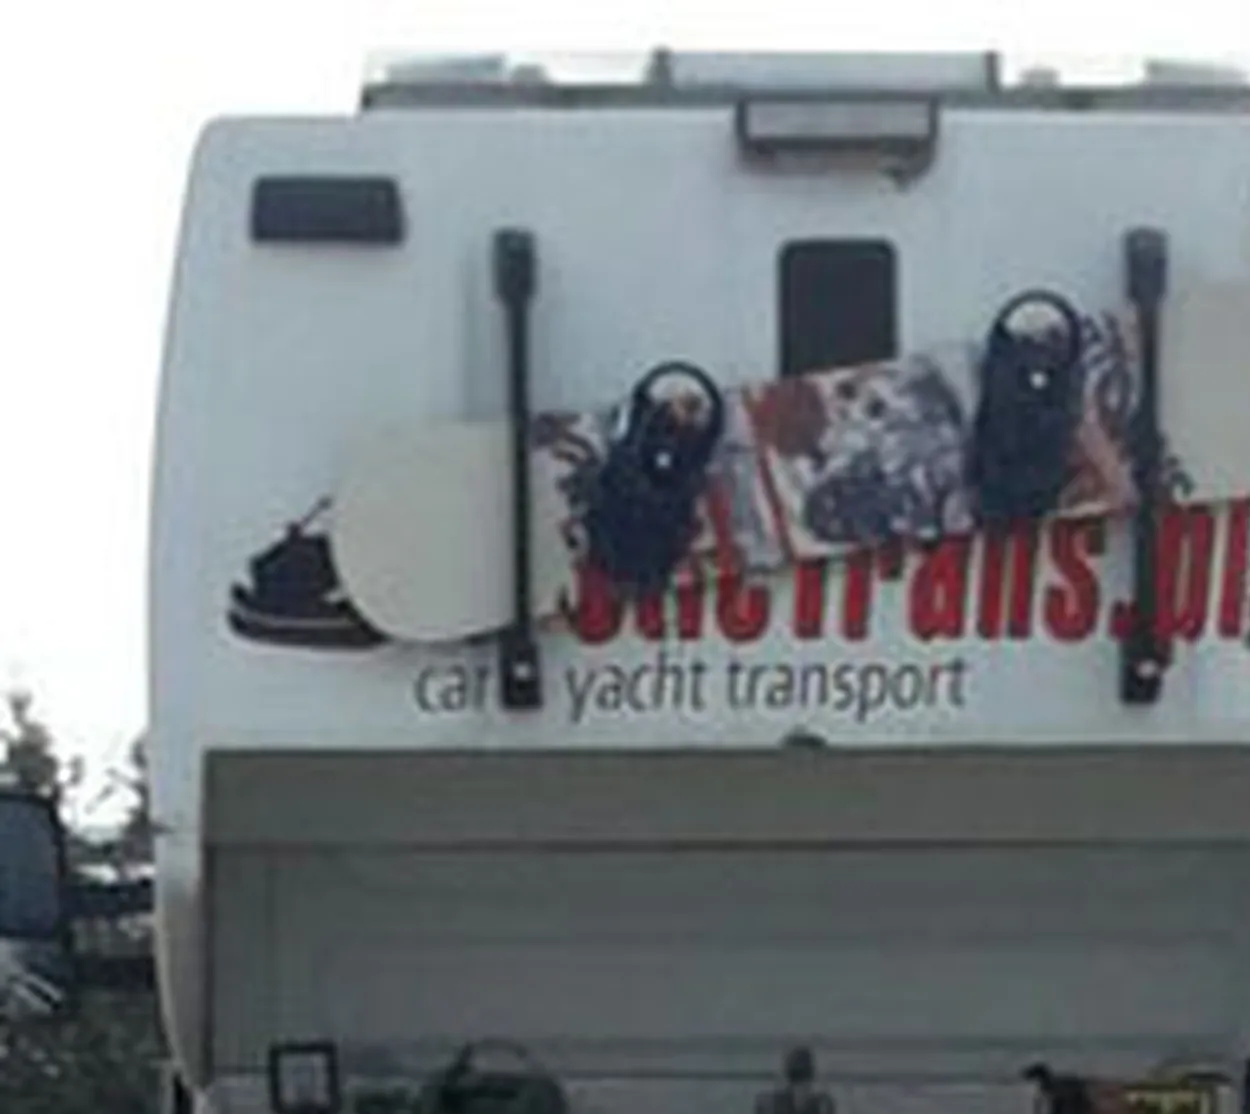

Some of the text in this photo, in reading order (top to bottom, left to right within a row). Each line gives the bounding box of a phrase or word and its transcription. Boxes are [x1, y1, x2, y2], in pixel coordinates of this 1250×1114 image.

[413, 646, 967, 723] car yacht transport
